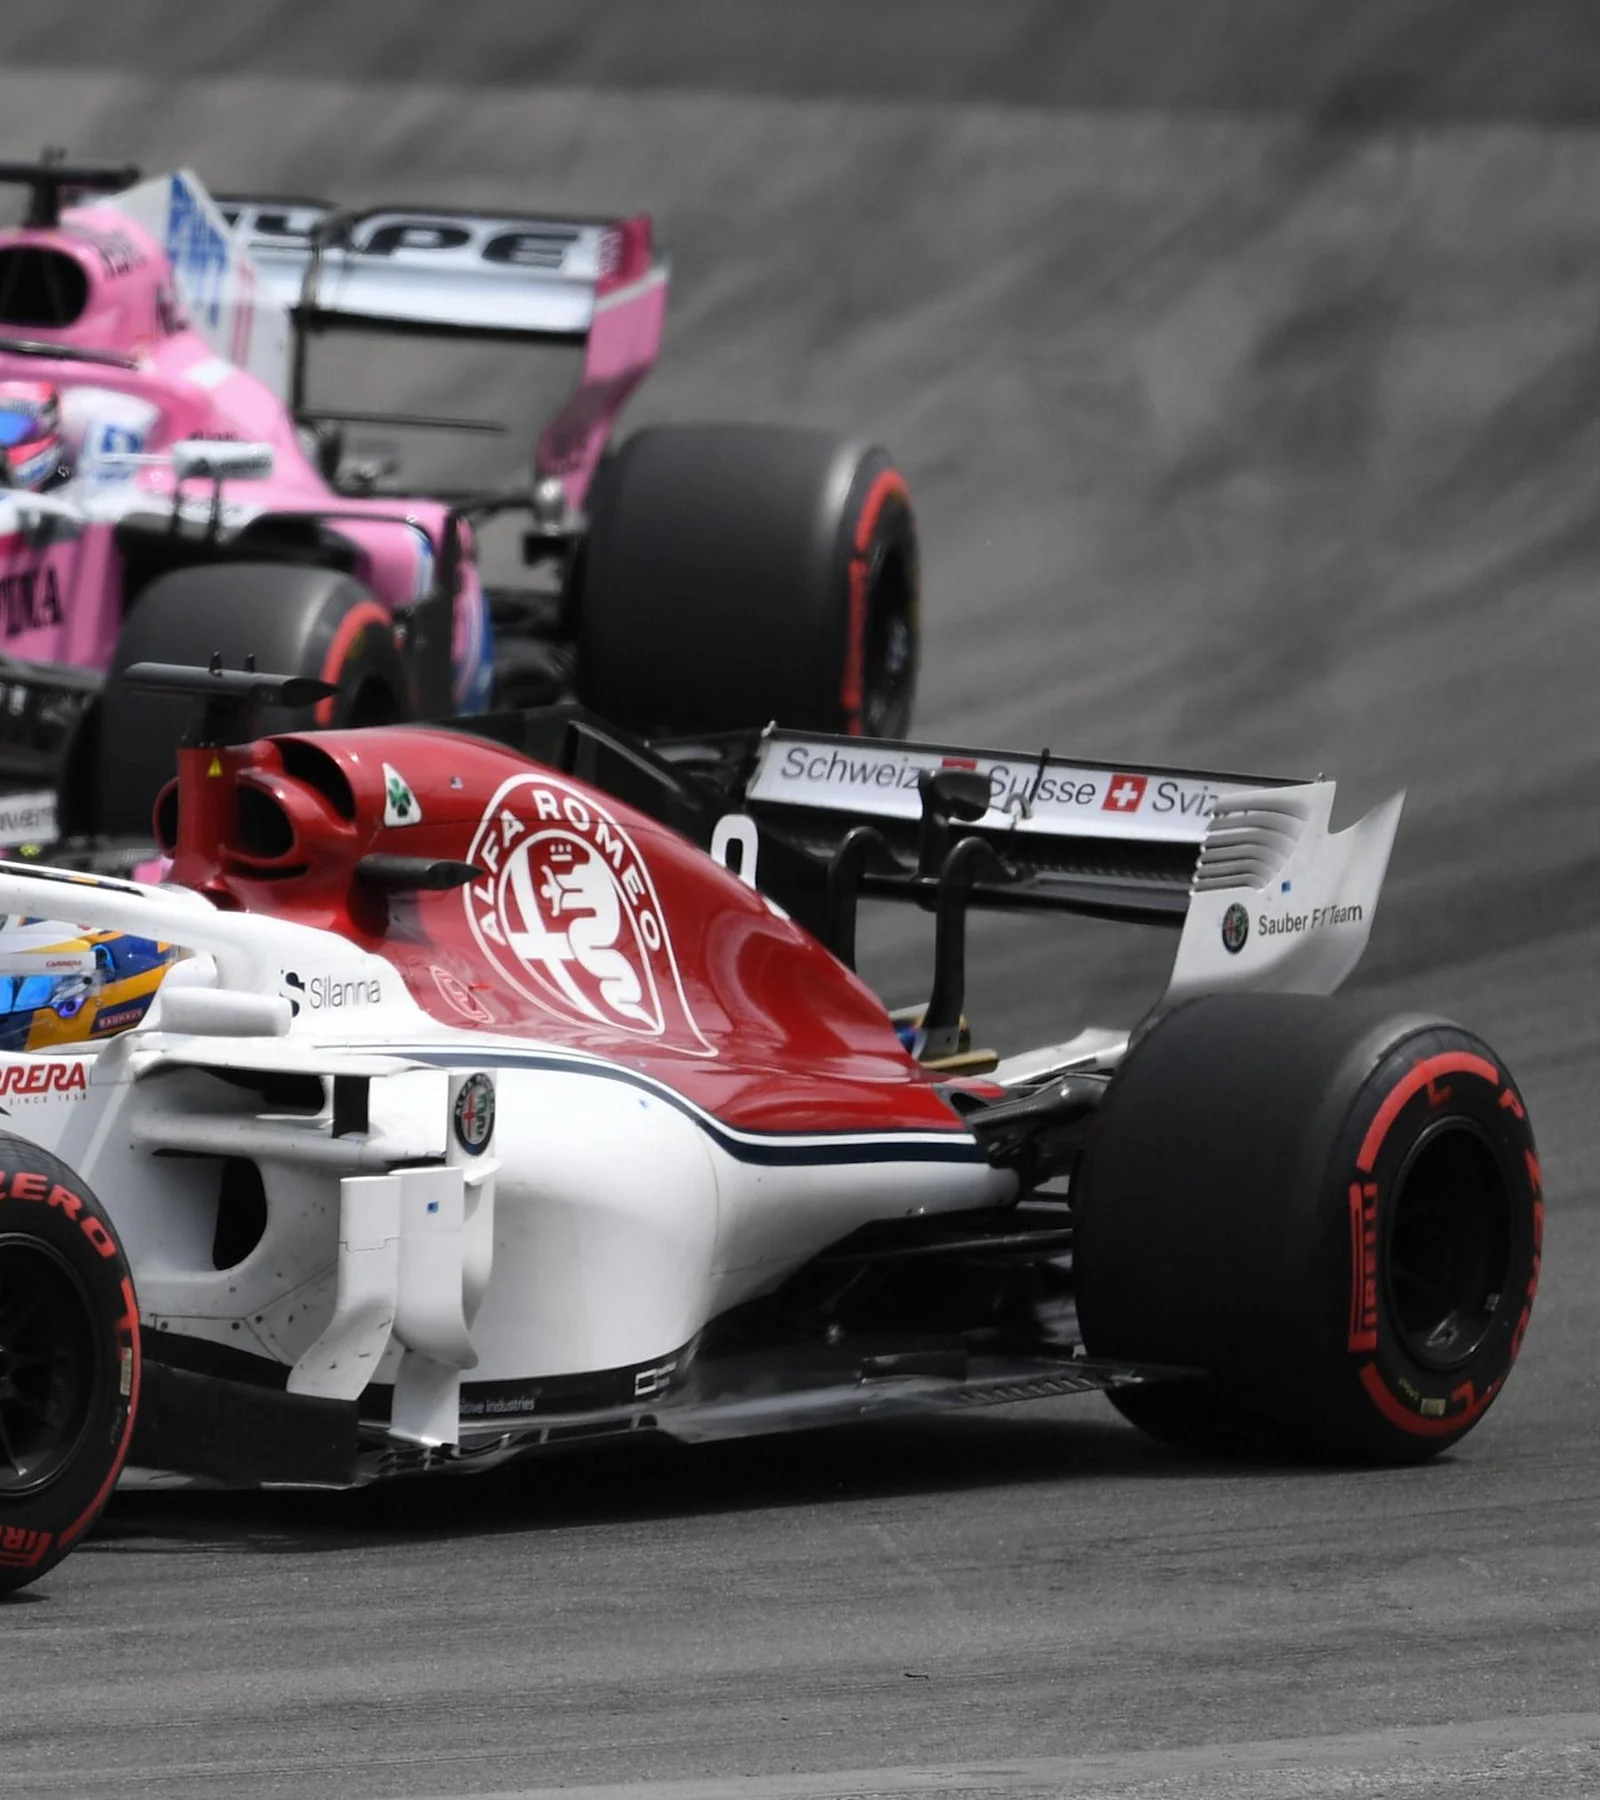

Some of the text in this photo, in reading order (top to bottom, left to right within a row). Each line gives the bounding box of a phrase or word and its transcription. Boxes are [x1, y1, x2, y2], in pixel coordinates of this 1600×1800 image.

[781, 746, 928, 790] Schweiz
[473, 789, 662, 951] ALFA ROMEO
[1258, 914, 1309, 937] Sauber
[1328, 904, 1363, 924] Team
[309, 975, 382, 1009] Silanna
